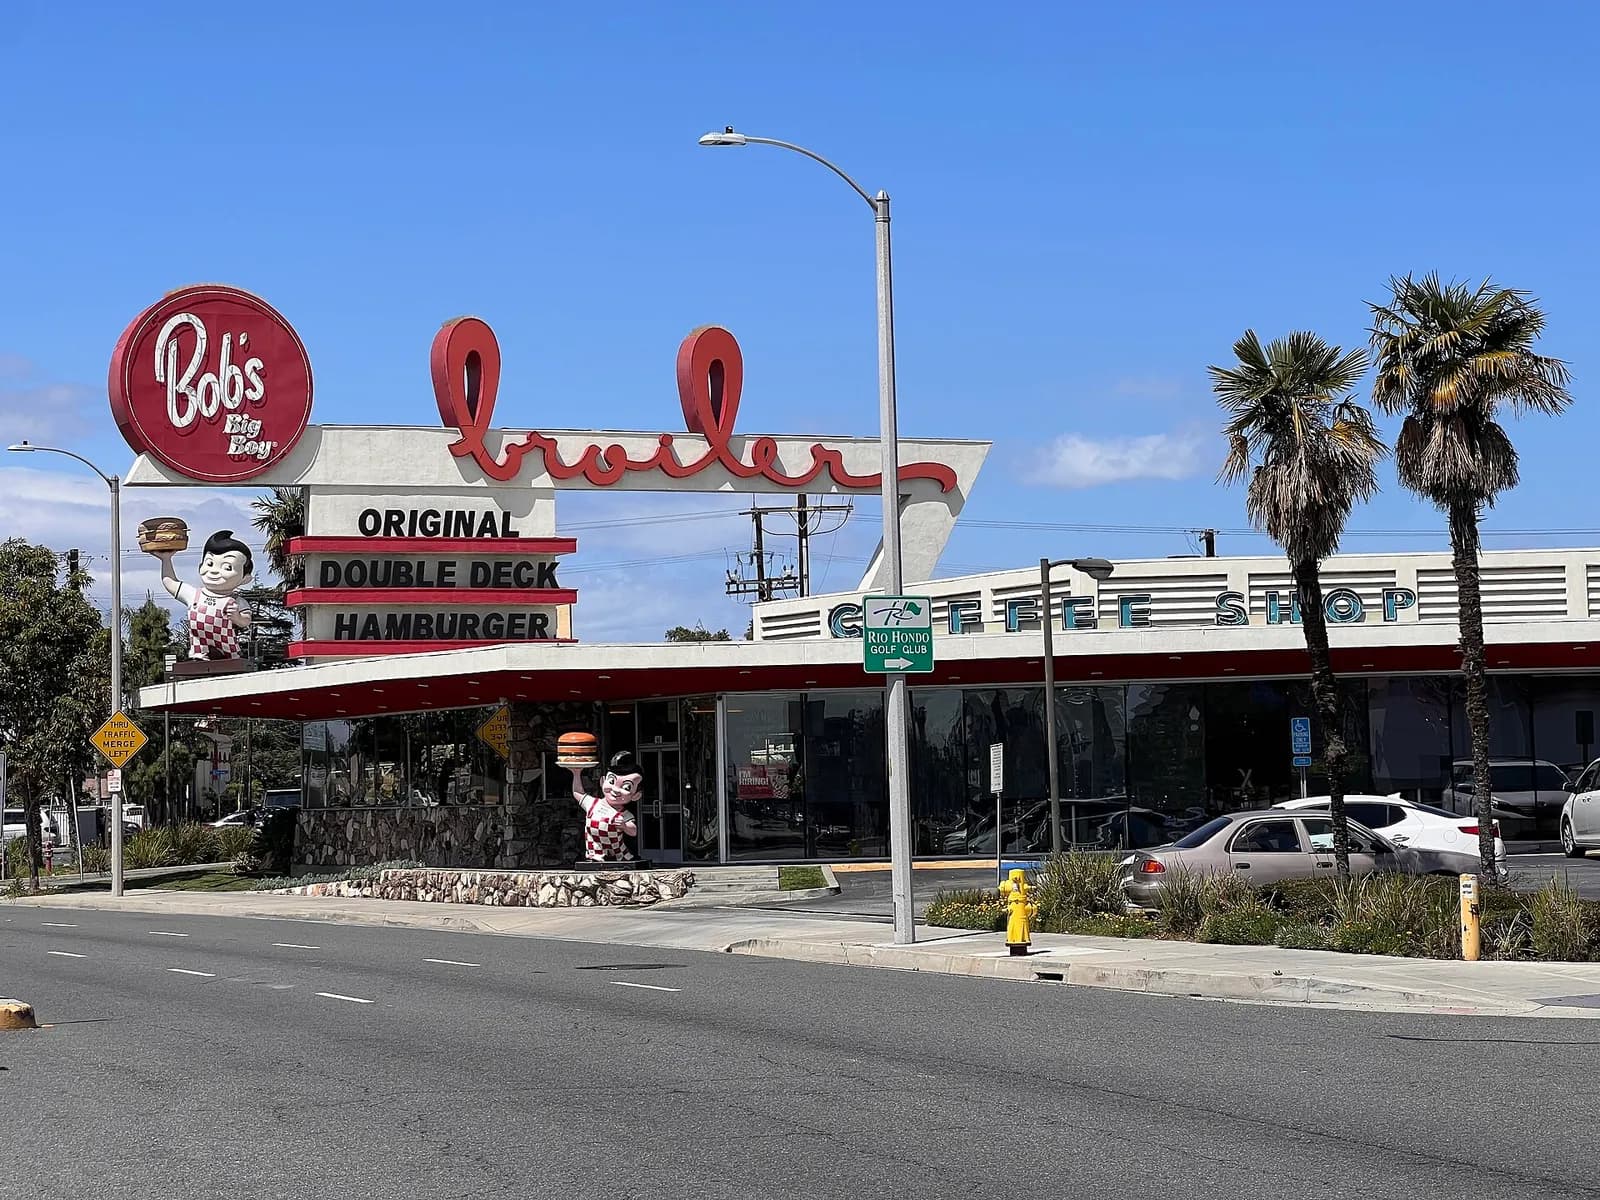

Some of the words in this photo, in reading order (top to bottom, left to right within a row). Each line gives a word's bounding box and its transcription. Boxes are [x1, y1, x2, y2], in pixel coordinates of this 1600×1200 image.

[154, 312, 265, 428] Bob's
[430, 316, 958, 494] broiler
[222, 413, 262, 439] Big
[358, 508, 520, 538] ORIGINAL
[319, 560, 457, 588] DOUBLE
[469, 561, 560, 589] DECK
[827, 594, 1151, 639] CFFEE
[1216, 588, 1416, 626] SHOP
[334, 612, 550, 641] HAMBURGER
[892, 631, 930, 643] HONDO
[870, 645, 897, 654] GOLF
[103, 730, 136, 738] TRAFFIC
[110, 721, 129, 729] THRU
[102, 740, 135, 748] MERGE
[108, 750, 129, 758] LEFT
[739, 777, 769, 786] HIRING!
